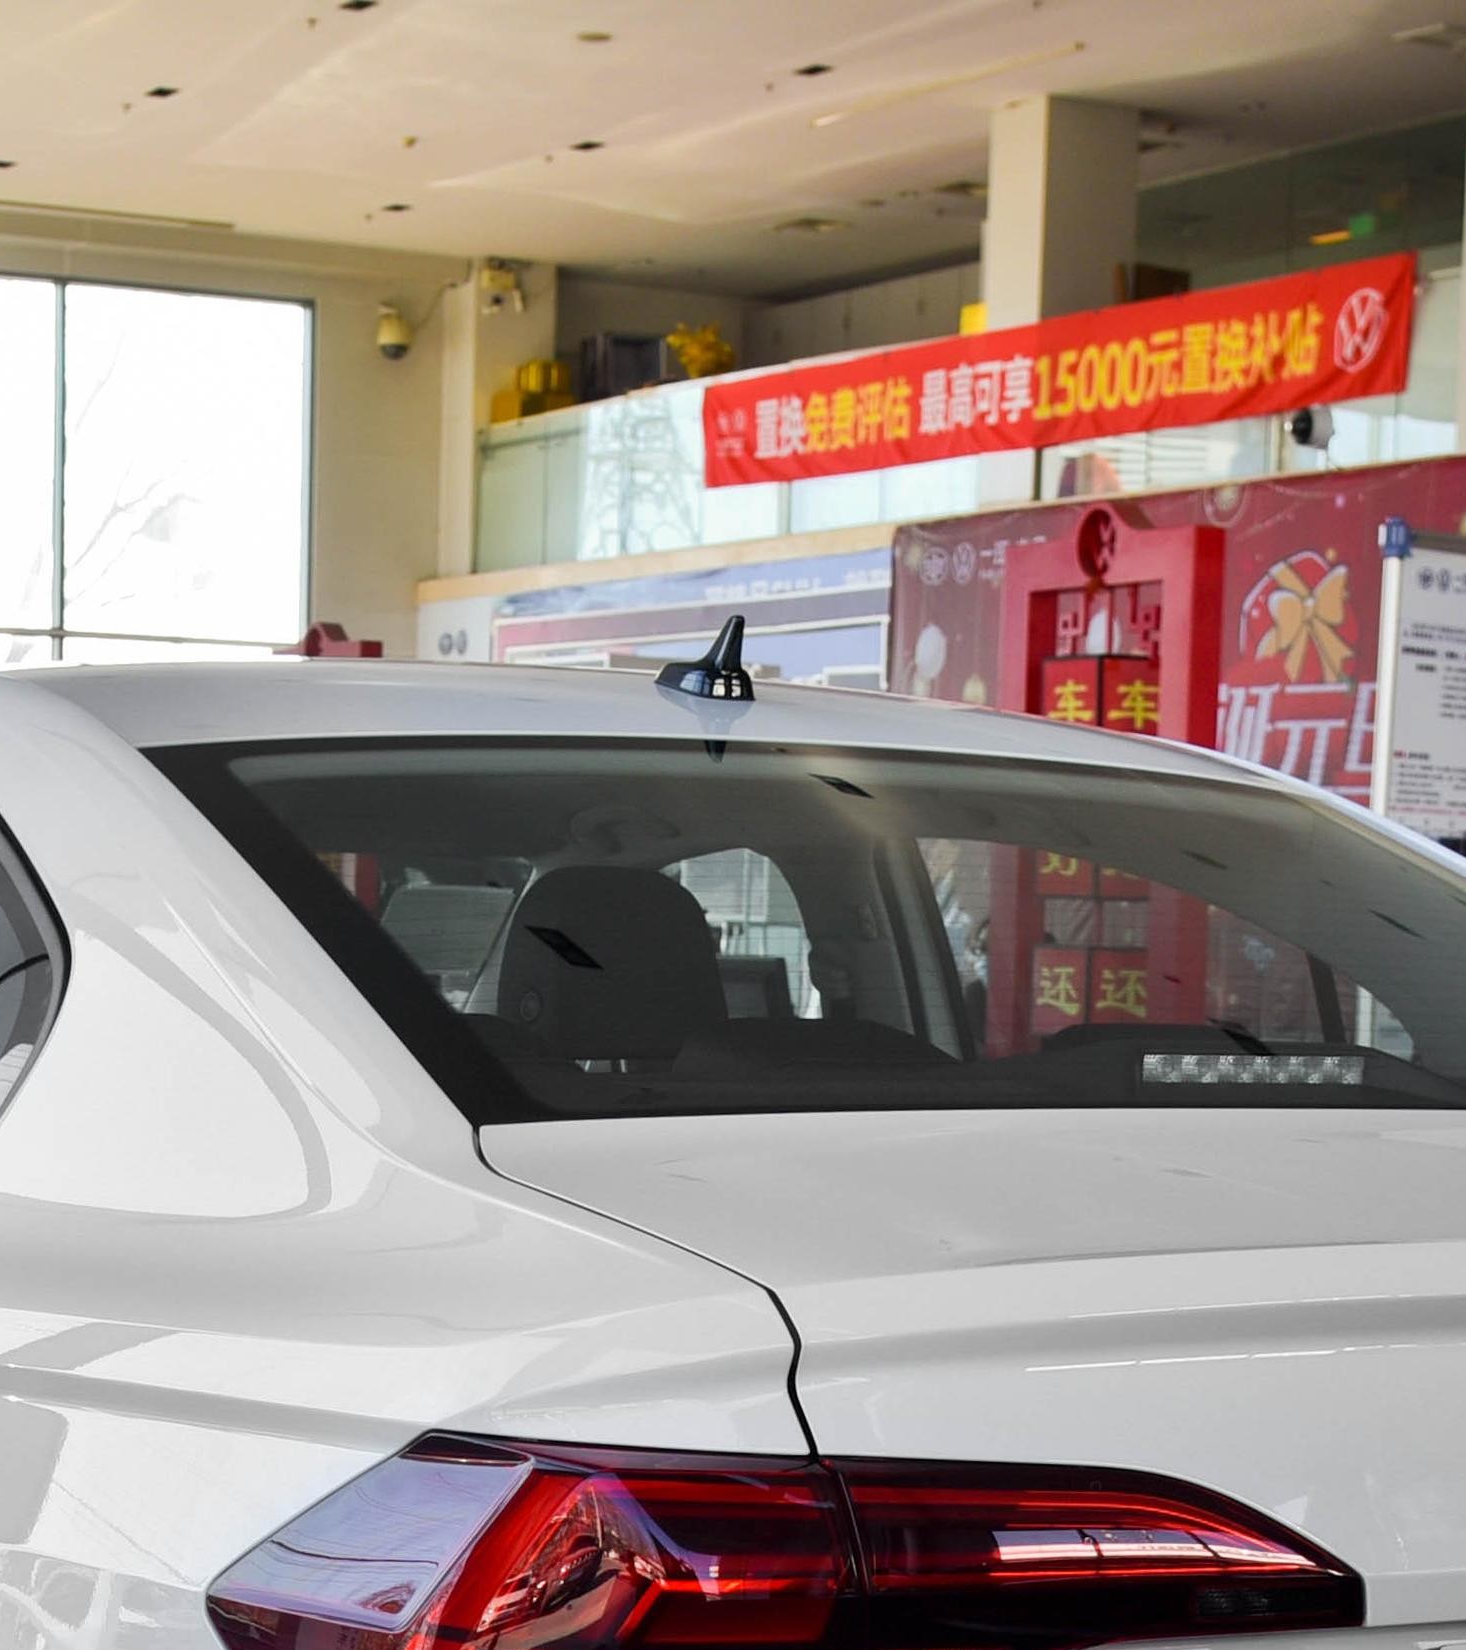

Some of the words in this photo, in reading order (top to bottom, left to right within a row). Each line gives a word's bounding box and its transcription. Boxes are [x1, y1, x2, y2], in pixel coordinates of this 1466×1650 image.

[754, 374, 911, 461] 置换免费评估
[918, 302, 1323, 436] 最高可享15000元置换补贴
